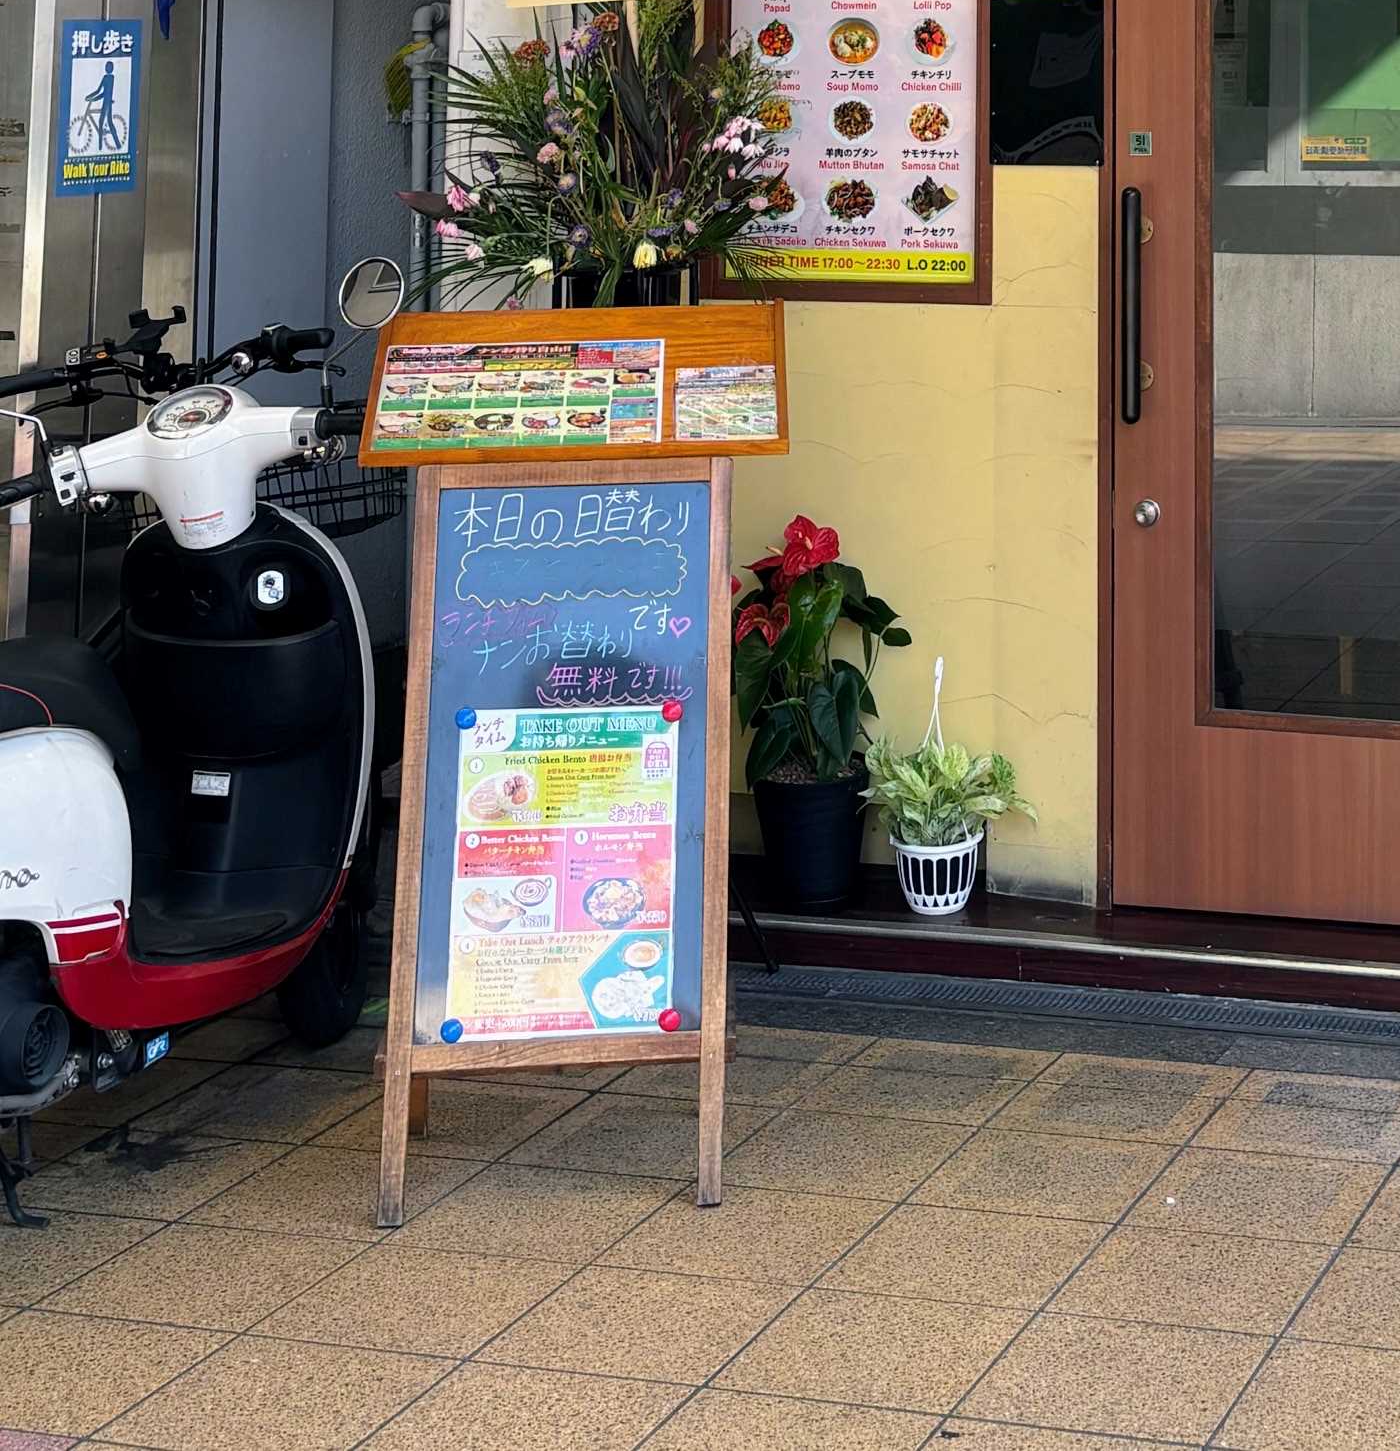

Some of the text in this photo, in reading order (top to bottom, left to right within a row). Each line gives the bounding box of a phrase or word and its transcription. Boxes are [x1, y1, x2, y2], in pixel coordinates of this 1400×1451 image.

[763, 3, 791, 14] Papad
[831, 0, 877, 11] Chowmein
[912, 0, 952, 11] Lolli Pop
[71, 29, 134, 56] 押し歩き
[826, 81, 879, 93] Soup Momo
[901, 81, 962, 92] Chicken Chilli
[63, 159, 130, 180] Walk Your Bike
[818, 160, 885, 171] Mutton Bhutan
[901, 161, 960, 171] Samosa Chat
[814, 237, 887, 248] Chicken Sekuwa
[900, 238, 960, 250] Pork Sekuwa
[788, 256, 819, 269] TIME
[931, 259, 967, 273] 22:00
[453, 488, 690, 548] 本日の日替わり
[519, 715, 658, 736] TAKE OUT MENU
[528, 754, 561, 765] Chicken
